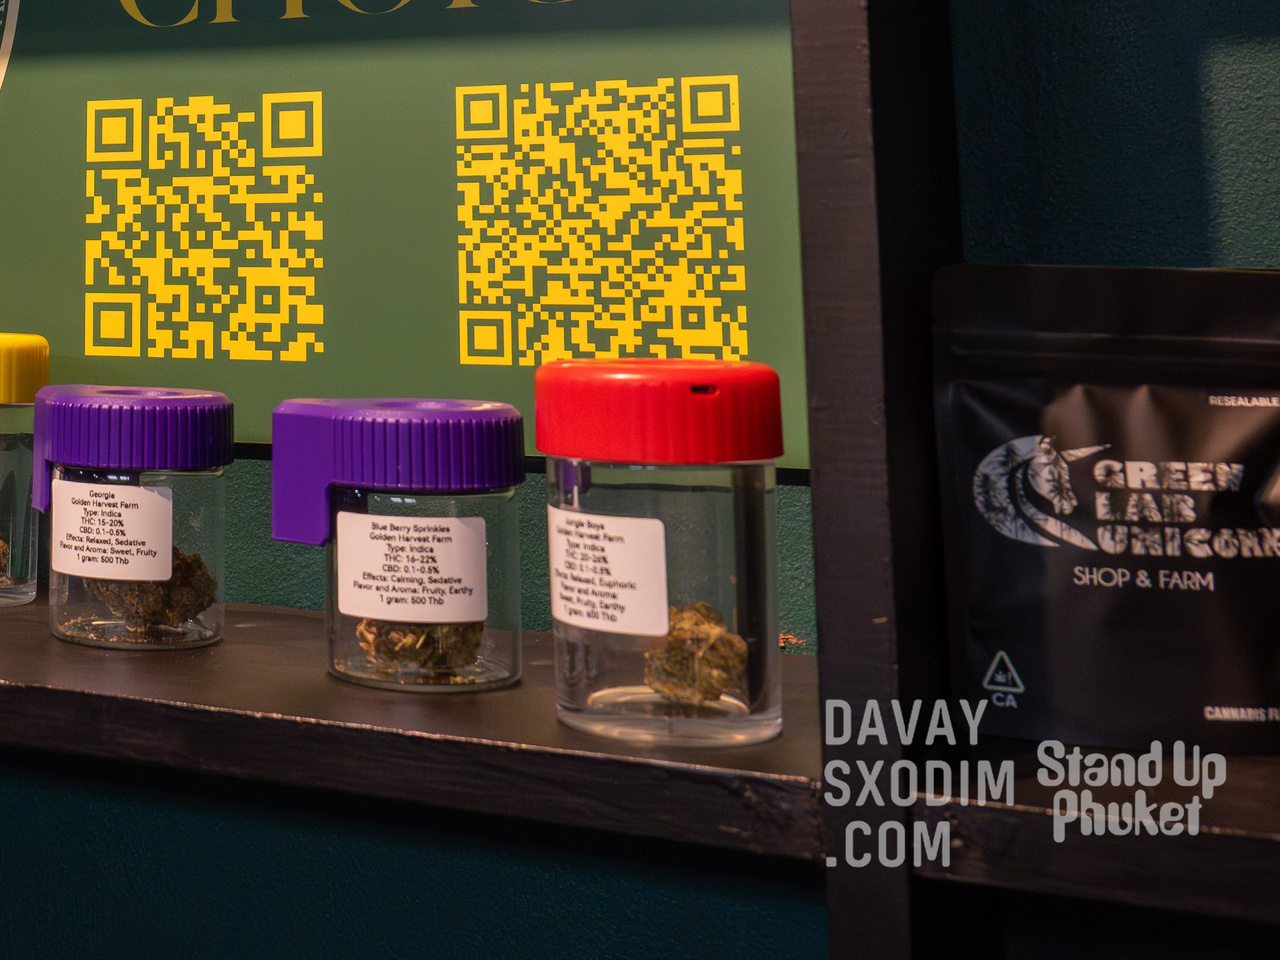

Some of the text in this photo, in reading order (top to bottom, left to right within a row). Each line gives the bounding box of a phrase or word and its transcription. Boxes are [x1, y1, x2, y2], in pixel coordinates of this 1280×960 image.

[1208, 395, 1280, 408] RESEALABLE
[1093, 459, 1245, 492] GREEN
[89, 490, 115, 499] Georgia
[71, 498, 91, 506] Golden
[93, 500, 118, 508] Harvest
[1095, 491, 1197, 523] LAB
[83, 508, 99, 517] Type:
[98, 519, 124, 527] 15-20%
[372, 522, 450, 533] Blue Berry Sprinkles
[80, 526, 126, 536] CBD: 0.1-0.5%
[66, 533, 83, 542] Effects:
[86, 537, 112, 545] Relaxed,
[370, 532, 396, 541] Golden
[60, 541, 72, 549] Flavor
[86, 546, 108, 554] Aroma:
[110, 548, 134, 556] Sweet,
[137, 549, 157, 557] Fruity
[387, 544, 434, 553] Type: Indica
[385, 554, 437, 563] THC: 16-22%
[382, 564, 439, 574] CBD: 0.1-0.5%
[363, 572, 387, 582] Effects:
[391, 575, 425, 585] Calming,
[1073, 565, 1215, 592] SHOP & FARM
[354, 581, 373, 590] Flavor
[376, 583, 389, 591] and
[391, 585, 419, 593] Aroma:
[450, 587, 473, 595] Earthy
[387, 596, 444, 605] gram: 500 Thb
[992, 692, 1018, 709] CA
